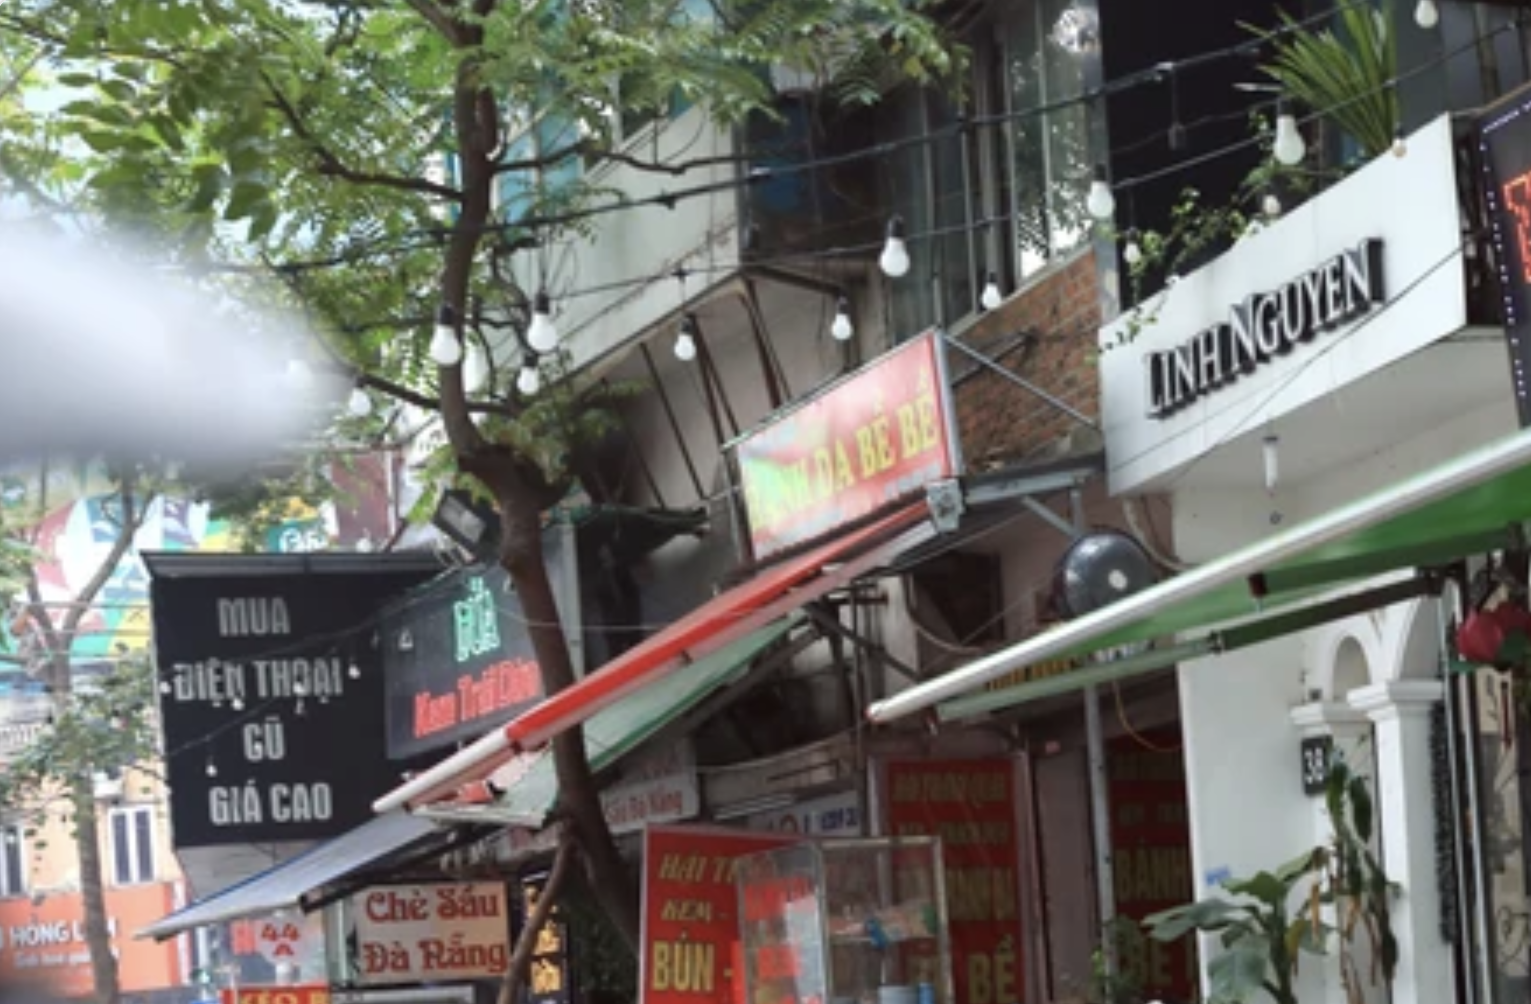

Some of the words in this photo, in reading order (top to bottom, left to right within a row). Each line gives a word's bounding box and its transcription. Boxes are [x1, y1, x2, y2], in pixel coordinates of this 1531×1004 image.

[1144, 324, 1234, 420] LINH
[1230, 236, 1384, 362] NGUYEN
[217, 596, 291, 637] MUA
[209, 778, 263, 826] GIÁ
[269, 782, 333, 823] CAO
[653, 929, 714, 992] BÚN
